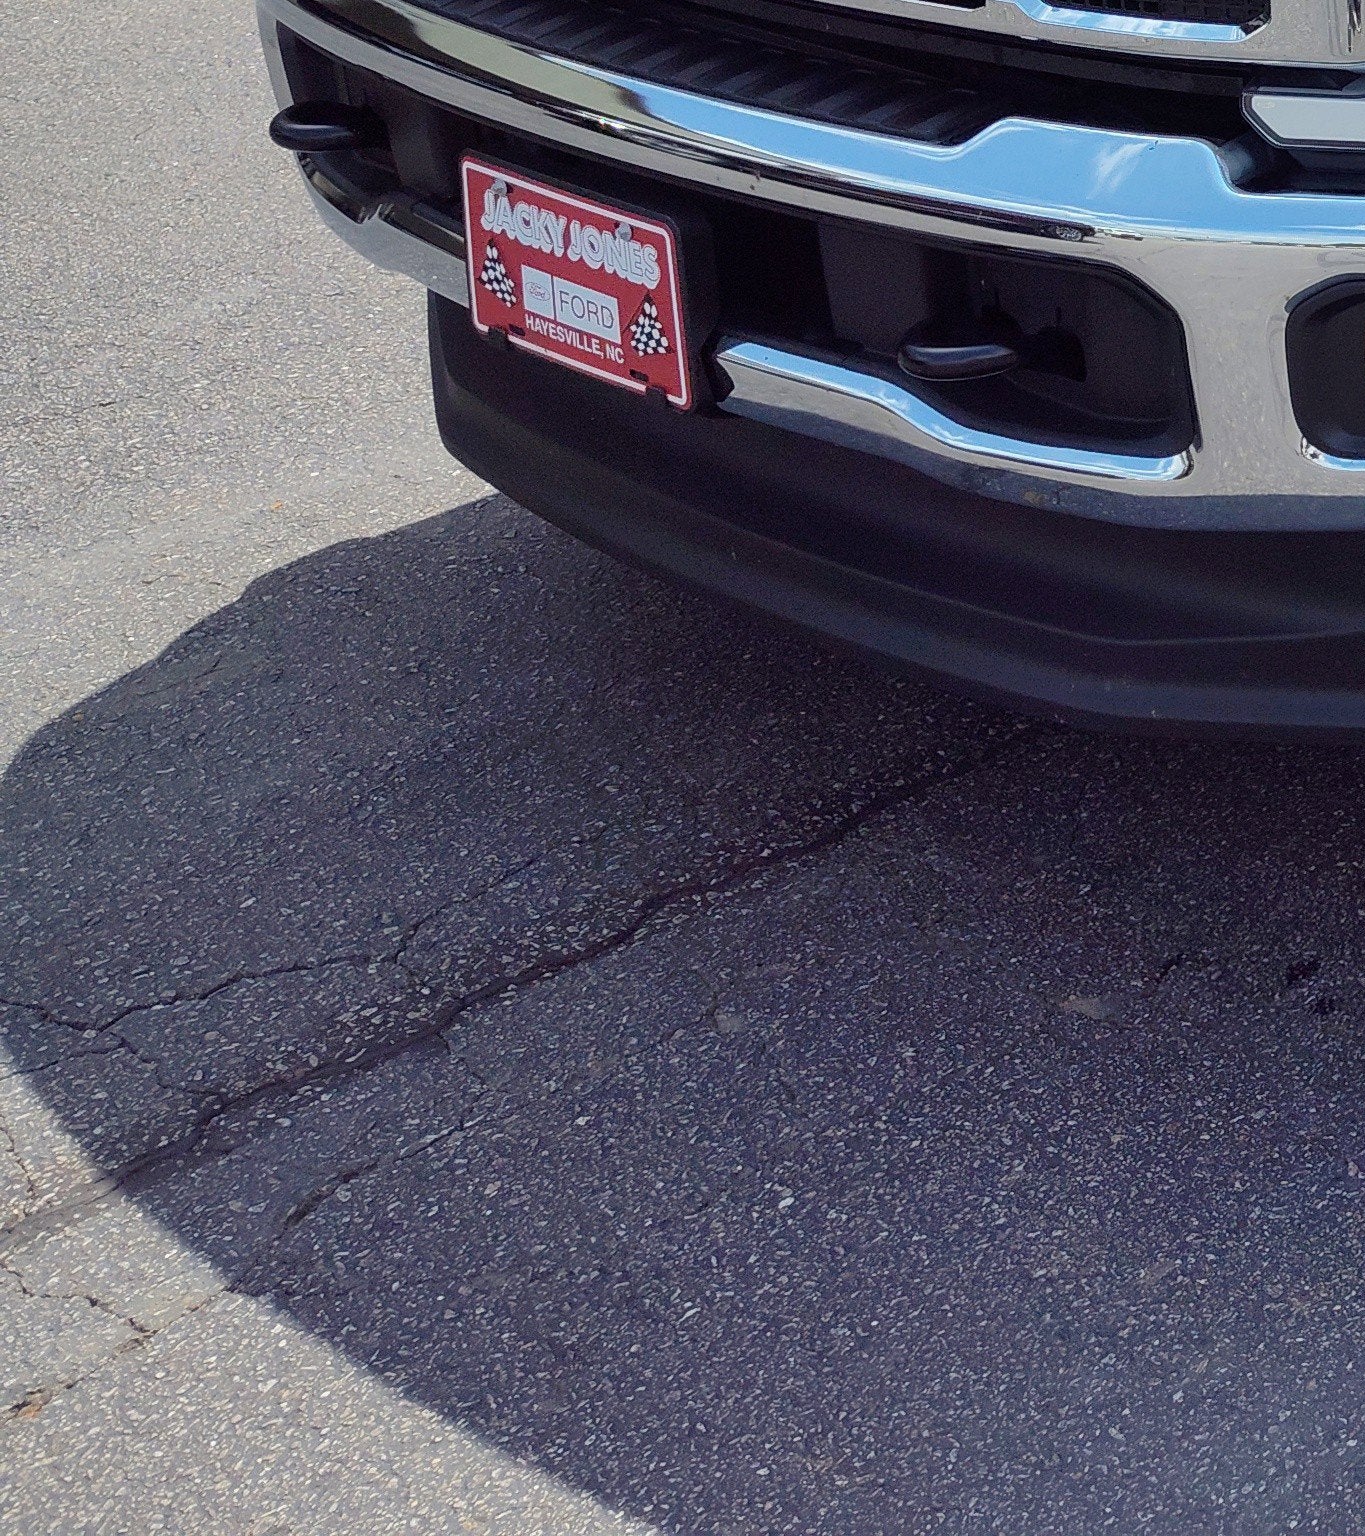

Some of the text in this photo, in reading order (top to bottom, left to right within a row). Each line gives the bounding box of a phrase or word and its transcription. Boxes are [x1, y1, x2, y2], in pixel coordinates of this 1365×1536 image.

[480, 188, 661, 291] JACKY JONES
[558, 289, 614, 330] FORD
[524, 313, 625, 365] HAYESVILLE, NC
